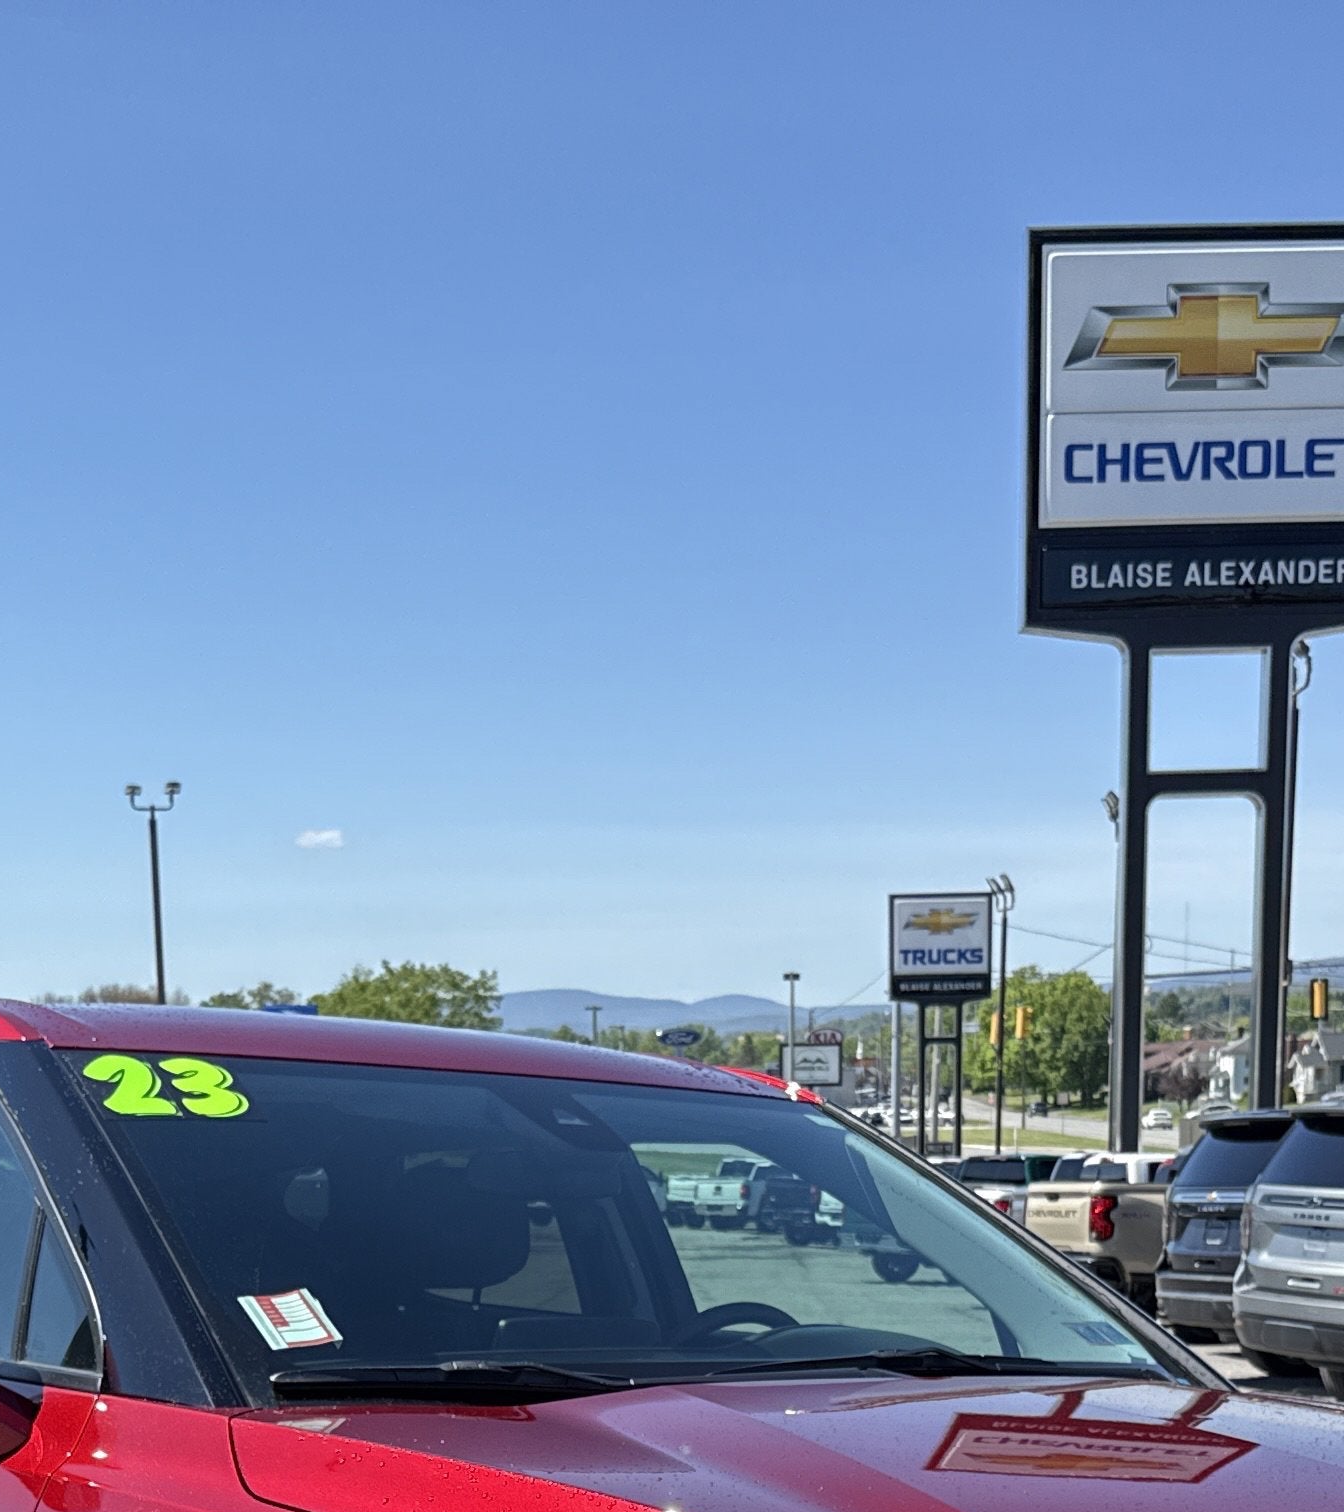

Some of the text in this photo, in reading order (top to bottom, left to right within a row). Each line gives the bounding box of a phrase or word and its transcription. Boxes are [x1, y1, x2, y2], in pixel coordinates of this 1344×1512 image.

[1070, 561, 1173, 590] BLAISE
[899, 947, 984, 965] TRUCKS
[899, 982, 983, 992] BLAISE ALEXANDER
[83, 1054, 249, 1118] 23
[1028, 1209, 1078, 1219] CHEVROLET
